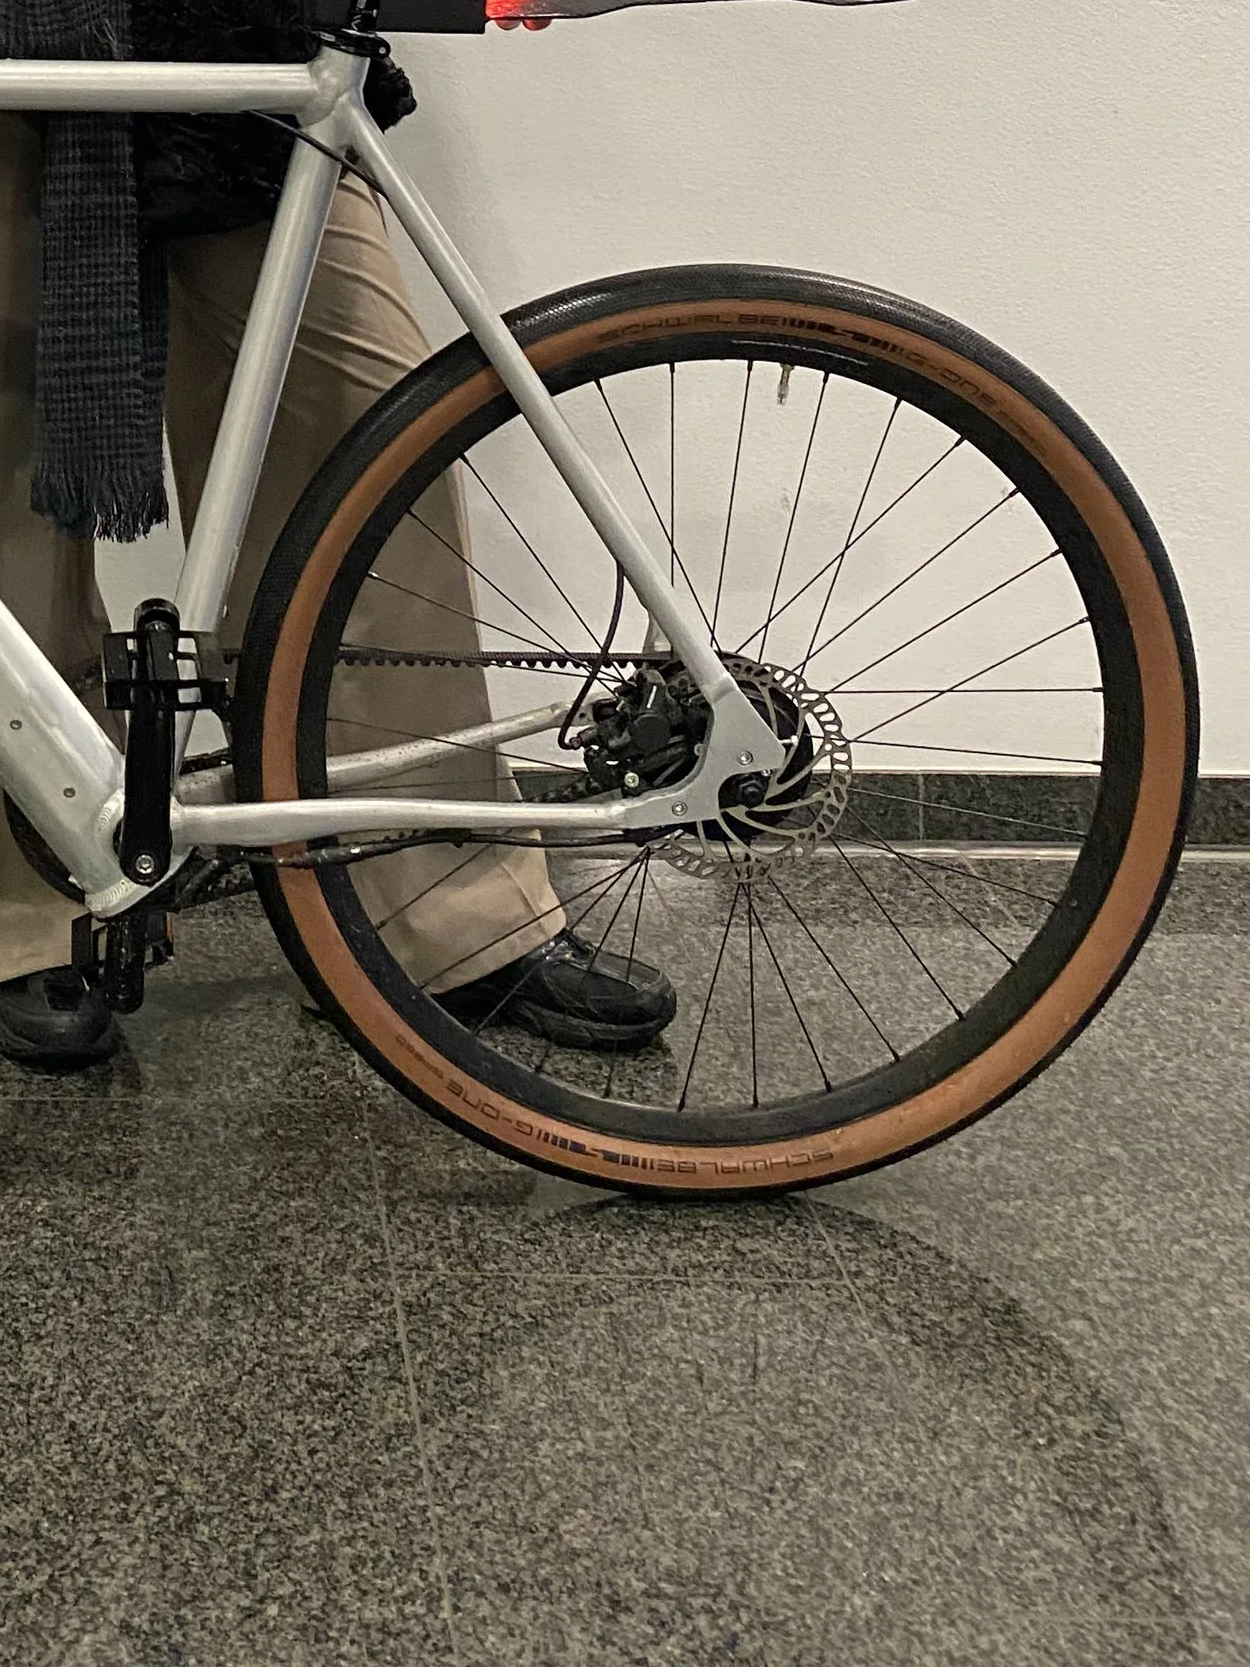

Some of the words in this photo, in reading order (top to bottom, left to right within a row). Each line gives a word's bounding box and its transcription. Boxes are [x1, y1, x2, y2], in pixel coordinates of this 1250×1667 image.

[598, 313, 779, 343] SCHWALBE
[906, 353, 998, 408] G-ONE
[446, 1079, 534, 1137] G-ONE
[657, 1147, 834, 1175] SCHWALBE
